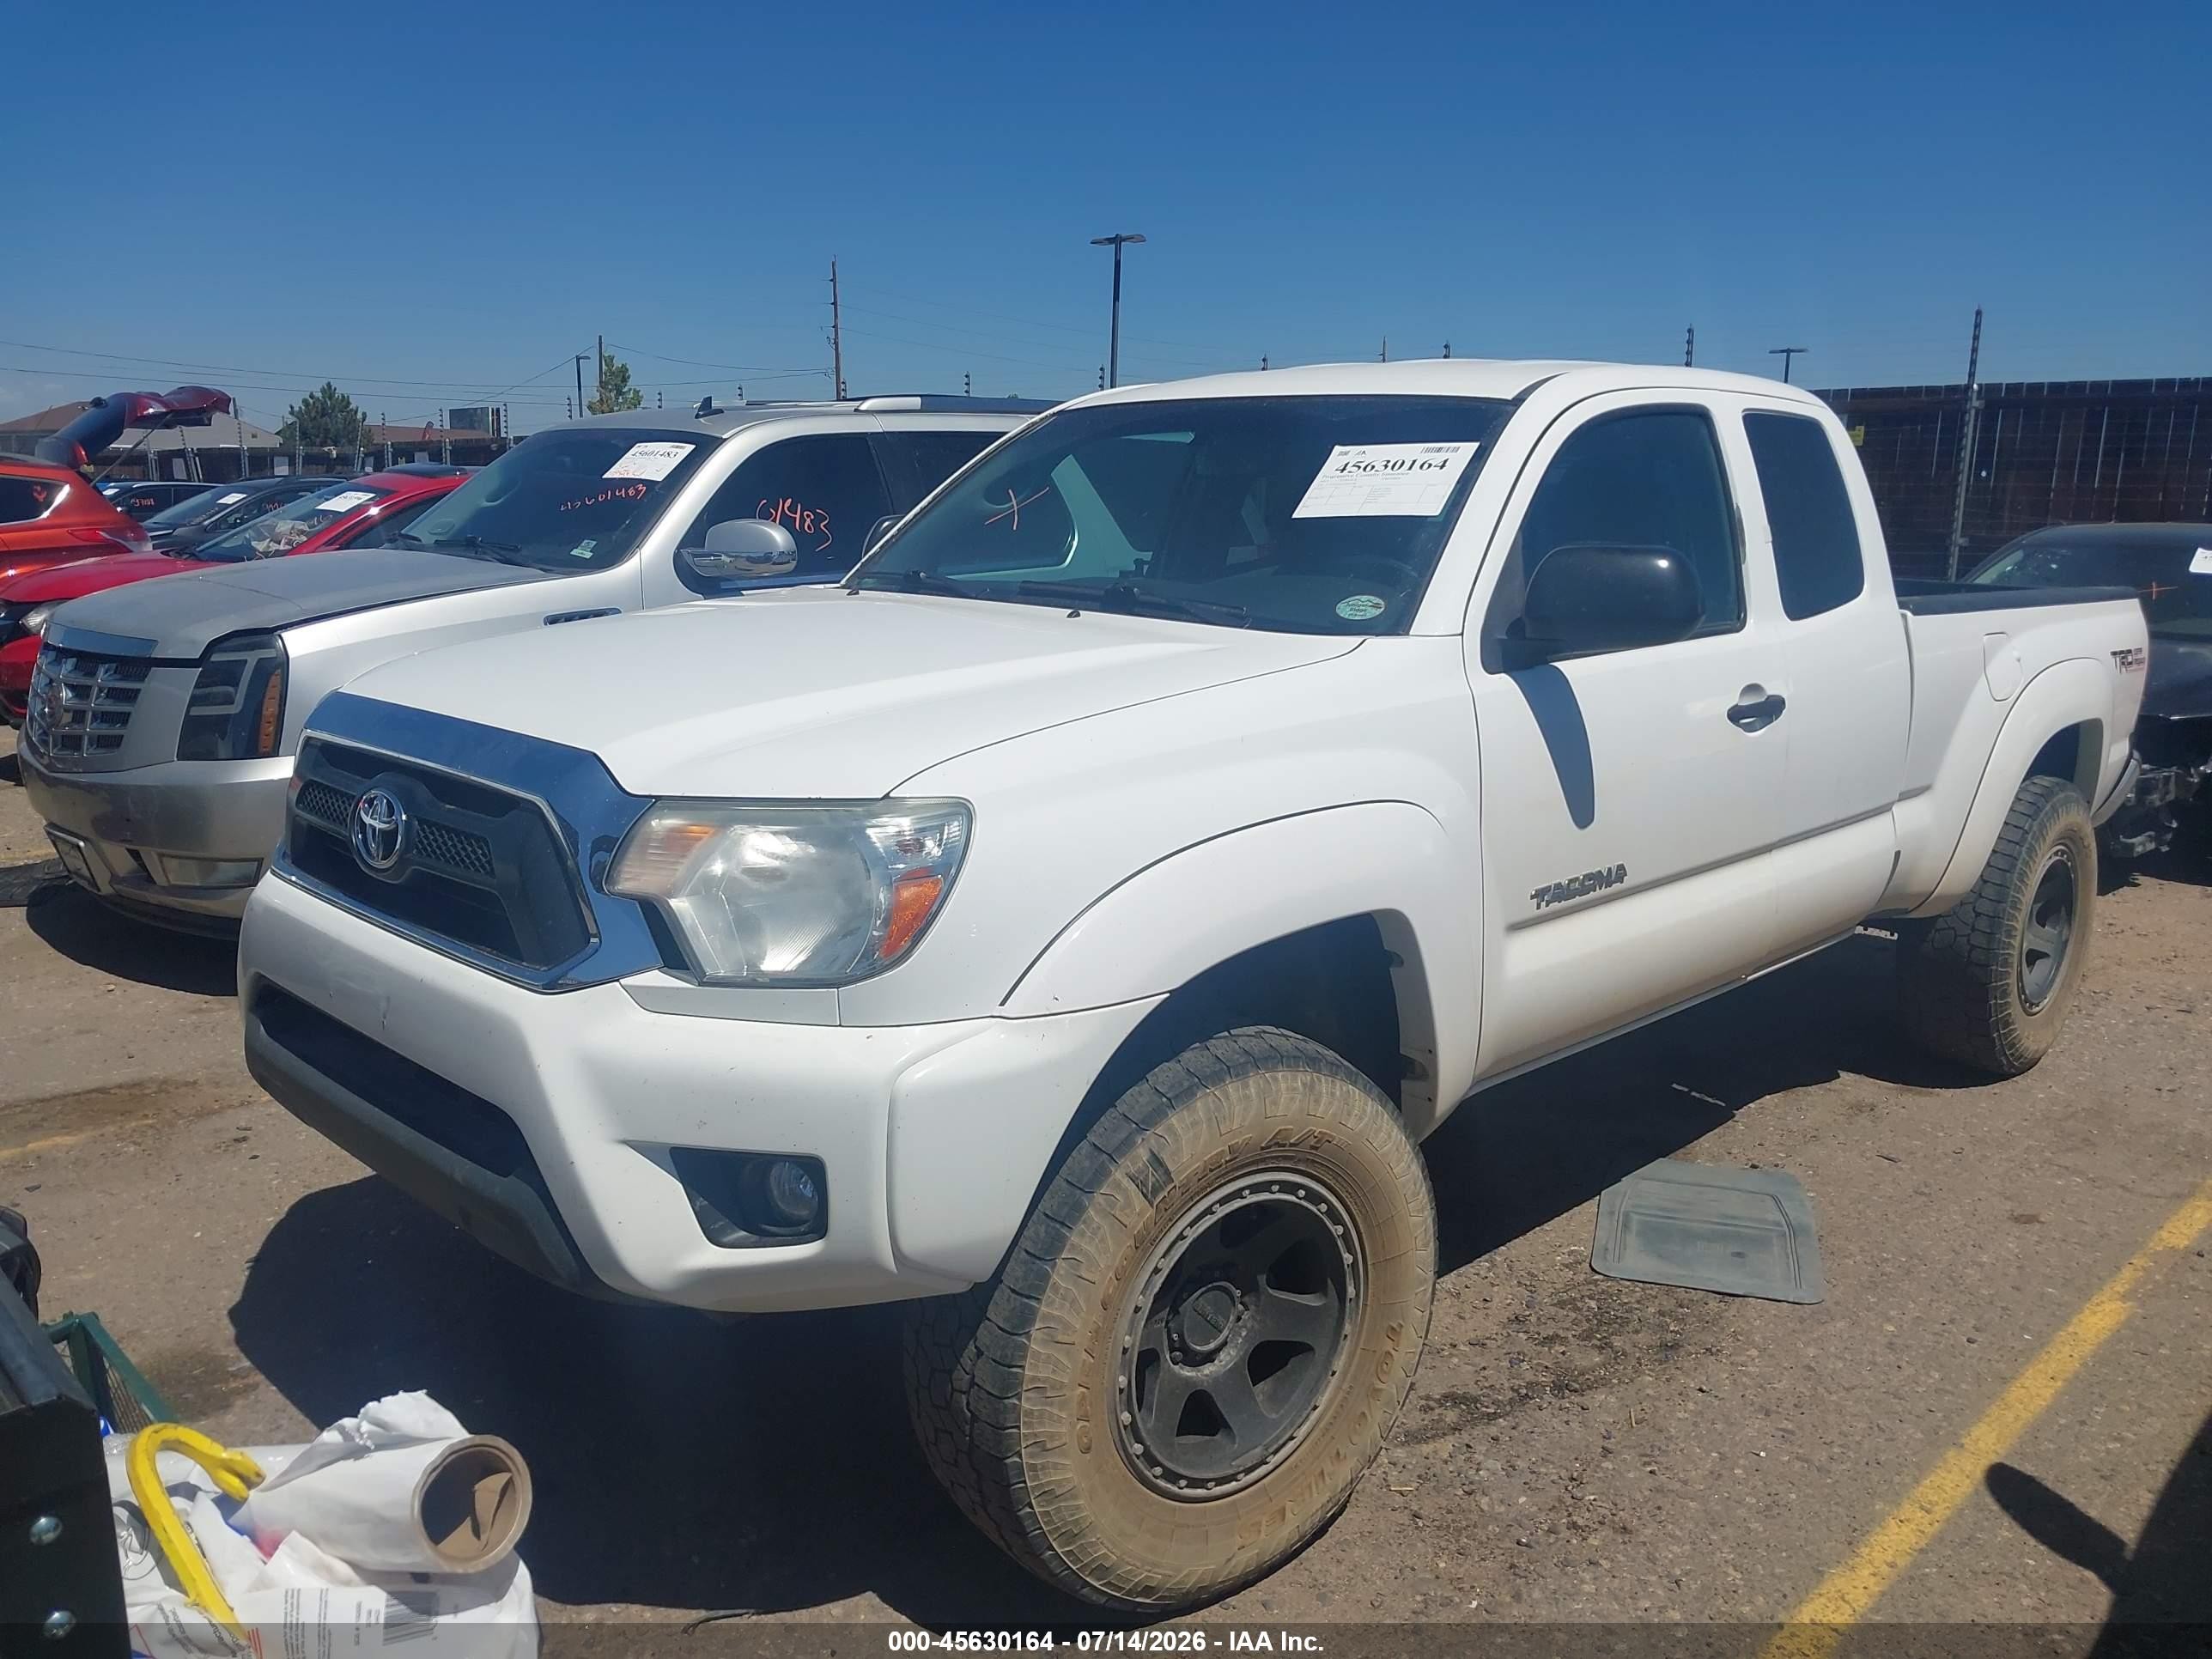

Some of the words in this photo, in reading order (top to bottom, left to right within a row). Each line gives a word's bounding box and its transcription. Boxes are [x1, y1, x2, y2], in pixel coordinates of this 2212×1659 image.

[1334, 458, 1449, 473] 45630164
[2110, 648, 2133, 673] TRD
[1529, 861, 1628, 910] TACOMA
